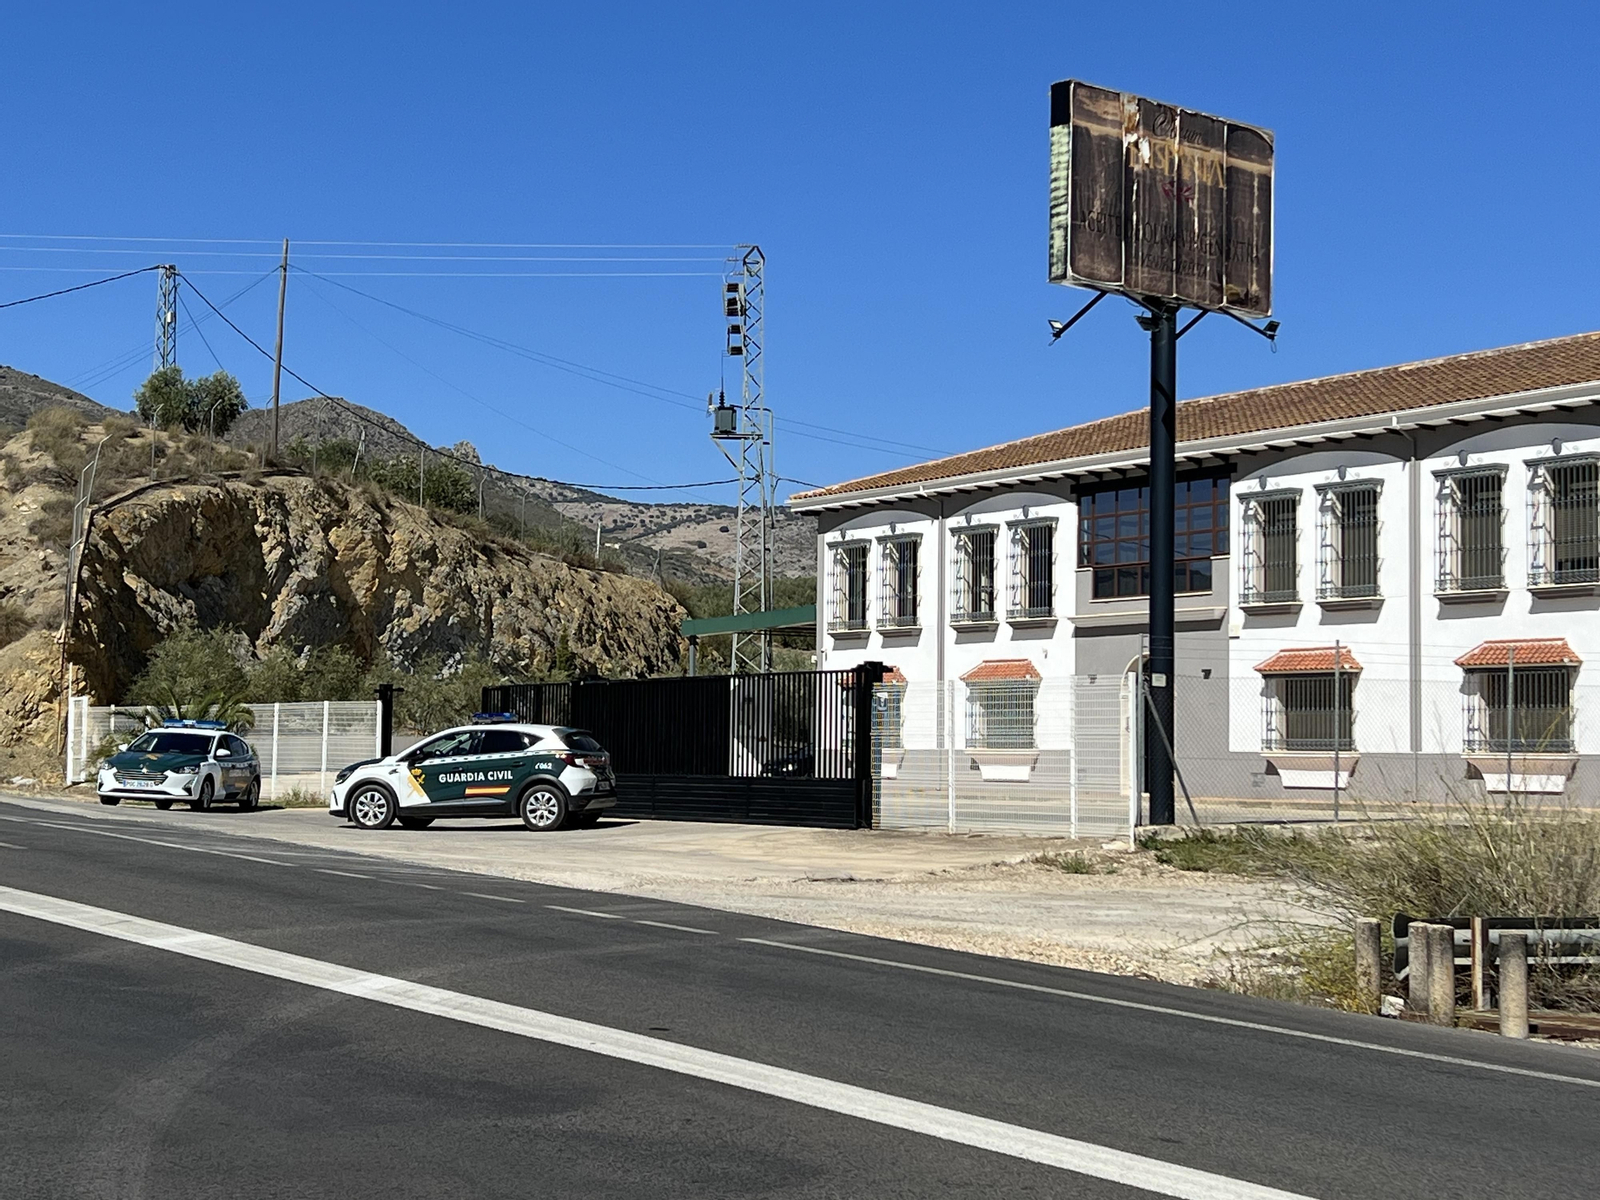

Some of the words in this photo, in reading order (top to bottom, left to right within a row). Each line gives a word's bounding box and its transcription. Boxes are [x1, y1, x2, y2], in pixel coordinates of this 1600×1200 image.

[1152, 110, 1203, 144] Olum
[1078, 209, 1121, 236] ACEITE
[439, 771, 485, 783] GUARDIA
[487, 770, 513, 780] CIVIL
